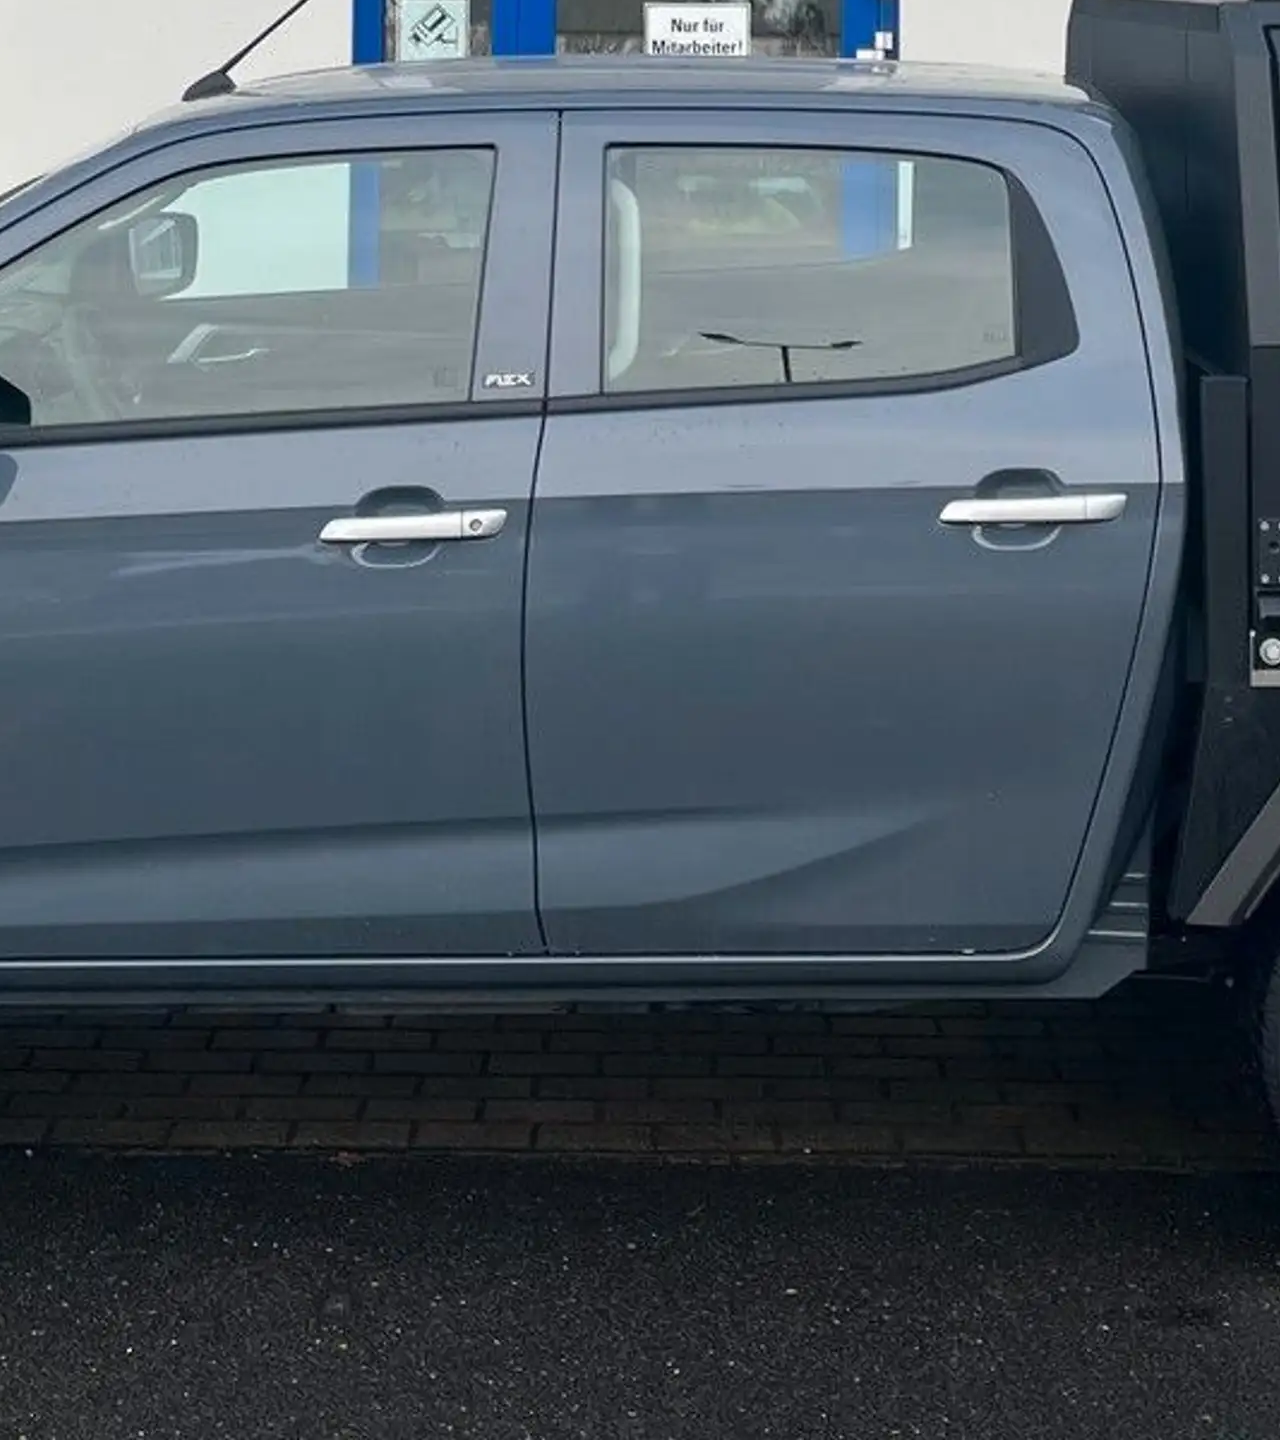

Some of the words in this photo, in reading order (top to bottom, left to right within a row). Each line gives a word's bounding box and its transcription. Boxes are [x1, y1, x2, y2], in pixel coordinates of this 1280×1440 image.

[670, 18, 700, 33] Nur
[702, 17, 724, 33] für
[651, 39, 743, 55] Mitarbeiter!
